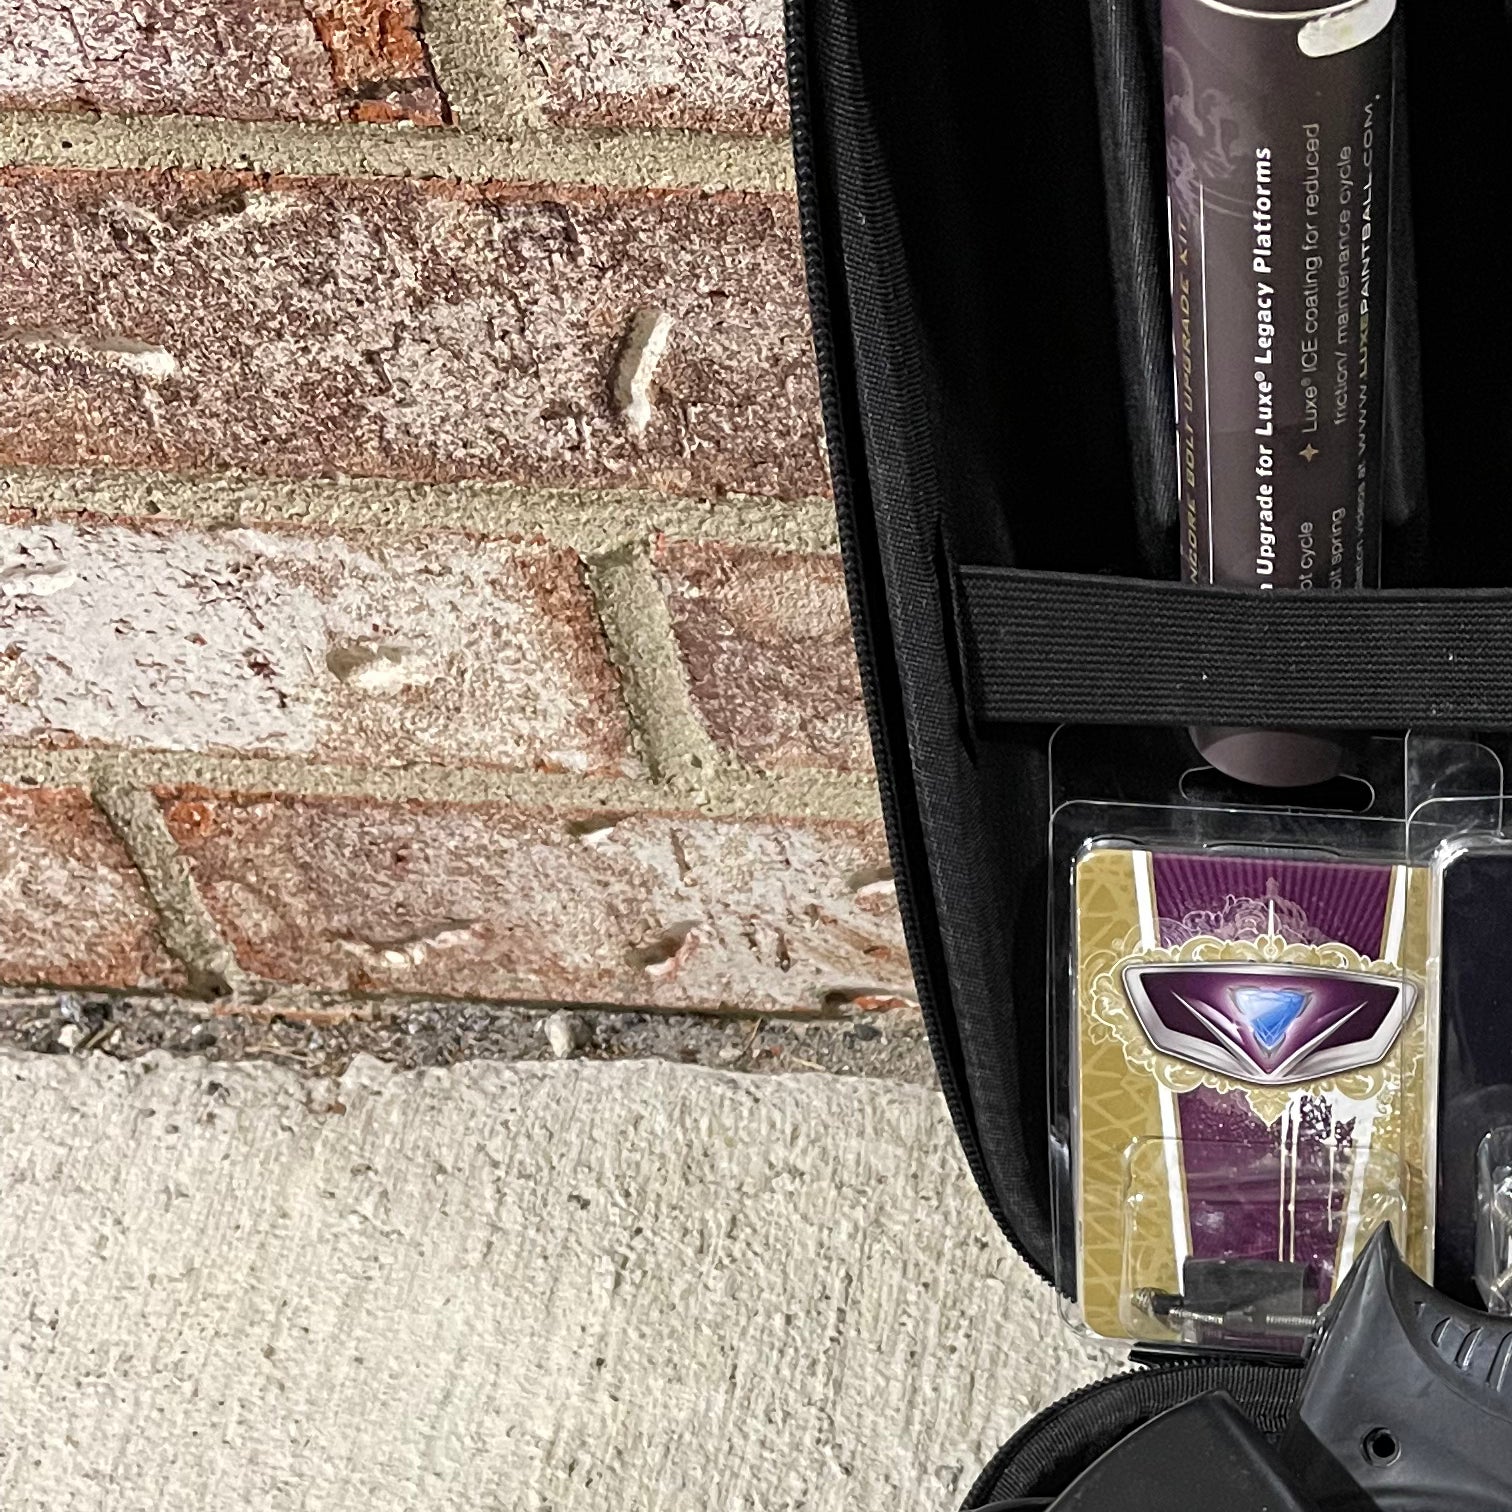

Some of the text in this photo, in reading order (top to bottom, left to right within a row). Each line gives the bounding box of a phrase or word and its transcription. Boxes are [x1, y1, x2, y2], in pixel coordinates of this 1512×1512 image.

[1302, 123, 1321, 216] reduced
[1337, 146, 1353, 205] cycle
[1177, 217, 1189, 266] KIT
[1253, 147, 1273, 273] Platforms
[1302, 223, 1320, 250] for
[1303, 256, 1323, 333] coating
[1335, 210, 1351, 345] maintenance
[1255, 282, 1275, 364] Legacy
[1301, 338, 1318, 373] ICE
[1184, 418, 1197, 488] BOLT
[1255, 444, 1273, 478] for
[1256, 484, 1275, 575] Upgrade
[1298, 521, 1317, 569] cycle
[1331, 506, 1346, 566] spring
